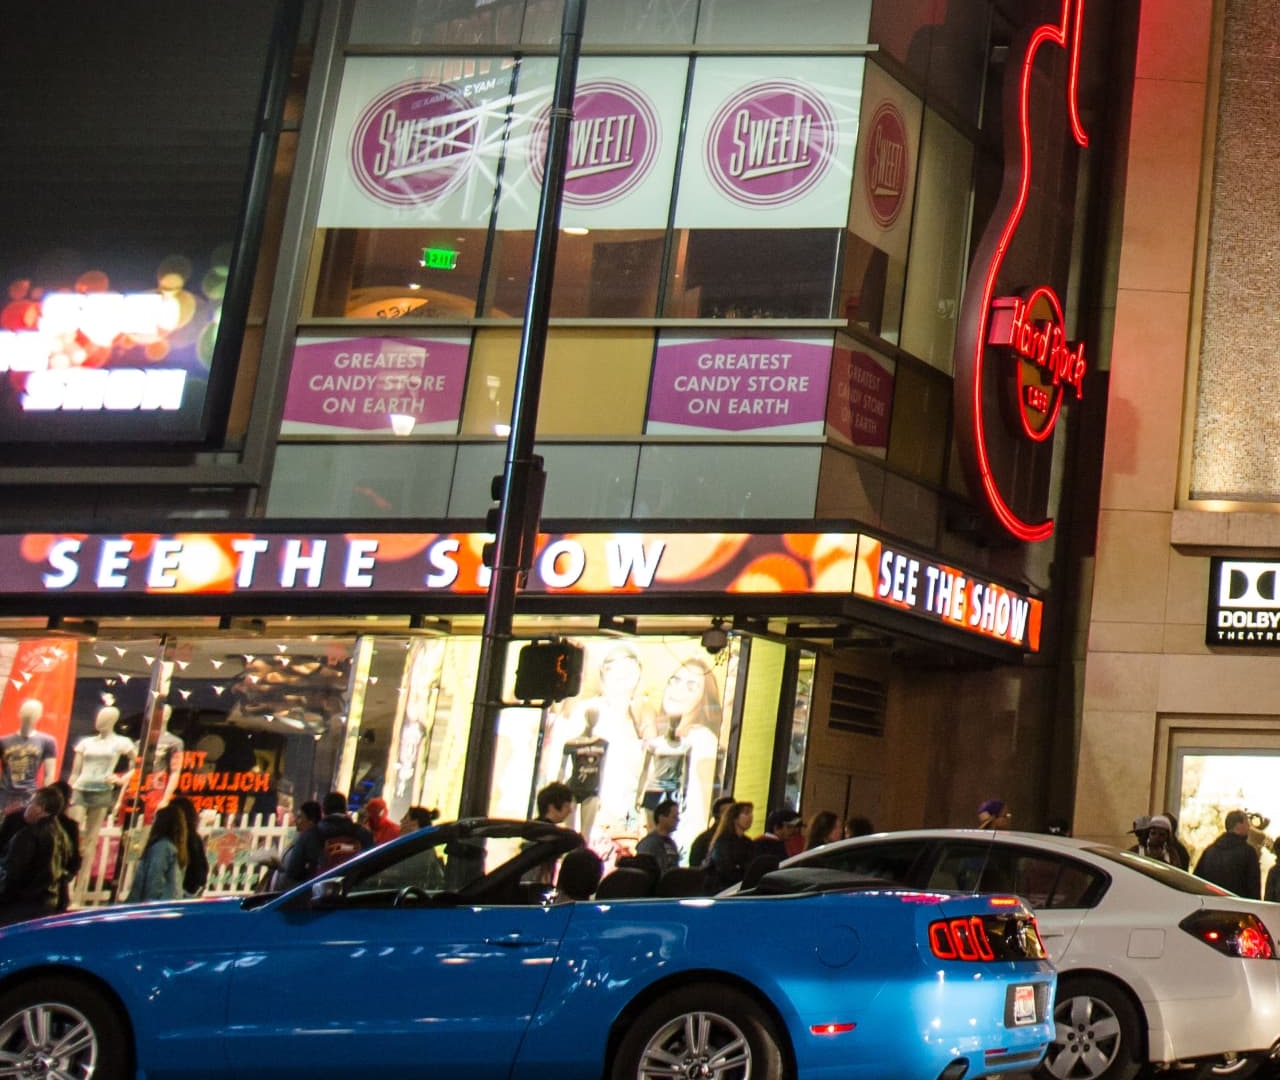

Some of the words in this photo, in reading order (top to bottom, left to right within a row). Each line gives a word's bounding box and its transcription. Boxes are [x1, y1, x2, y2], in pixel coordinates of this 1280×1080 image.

[571, 114, 636, 167] WEET!
[729, 109, 812, 177] SWEET!
[1009, 299, 1052, 367] Hard
[334, 352, 430, 369] GREATEST
[697, 353, 793, 370] GREATEST
[309, 375, 377, 392] CANDY
[383, 375, 446, 392] STORE
[674, 376, 742, 392] CANDY
[747, 376, 810, 392] STORE
[322, 397, 356, 414] ON
[363, 397, 426, 414] EARTH
[687, 398, 721, 415] ON
[728, 398, 789, 415] EARTH
[44, 538, 184, 589] SEE
[231, 538, 379, 589] THE
[426, 538, 667, 589] SOW
[878, 550, 920, 606] SEE
[925, 565, 966, 621] THE
[971, 582, 1029, 641] SHOW
